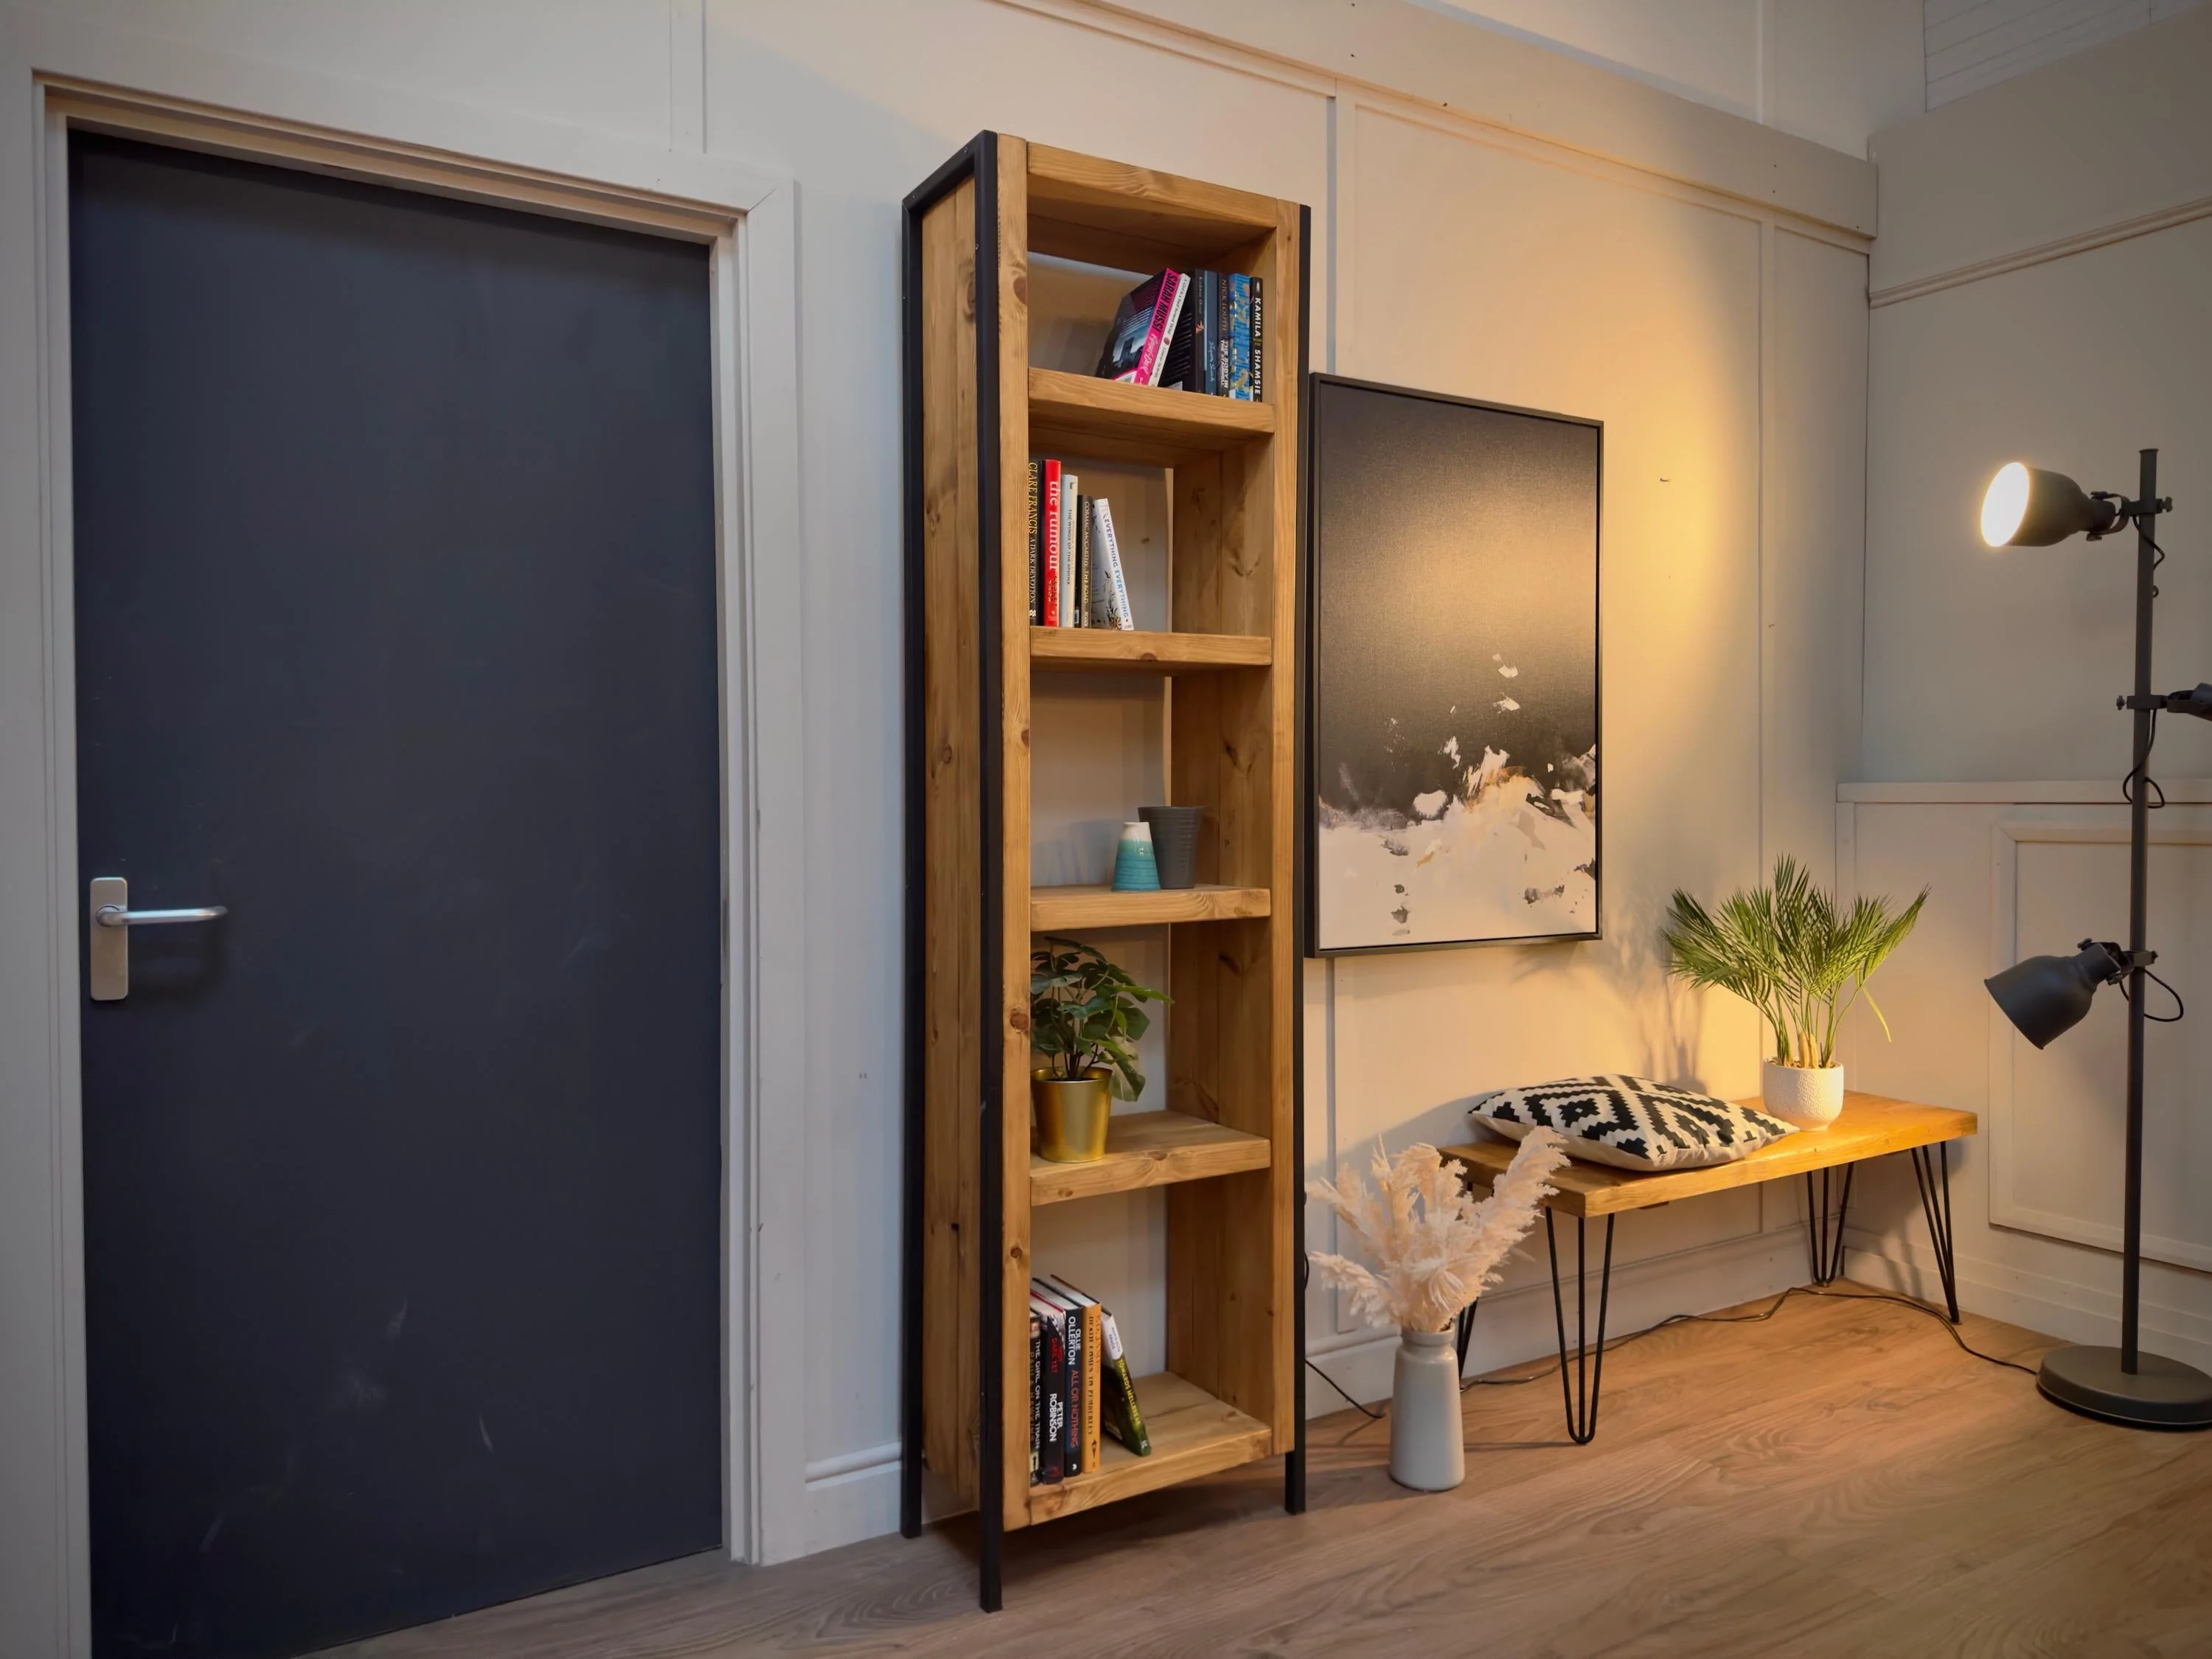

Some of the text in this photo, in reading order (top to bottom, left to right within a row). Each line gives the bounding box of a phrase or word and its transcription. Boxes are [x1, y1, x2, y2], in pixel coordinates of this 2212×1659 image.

[1152, 273, 1178, 333] SARAH MUSSI
[1224, 380, 1228, 388] IN
[1029, 462, 1037, 534] CLARE FRANCIS
[1049, 481, 1060, 506] the
[1049, 510, 1060, 571] rumour
[1105, 518, 1119, 568] EVERYTHING
[1114, 570, 1129, 618] EVERYTHING
[1035, 1385, 1040, 1399] ON
[1088, 1376, 1093, 1386] TO
[1118, 1358, 1131, 1390] TOWARDS
[1049, 1393, 1057, 1441] ROBINSON
[1070, 1369, 1079, 1448] ALL OR NOTHING
